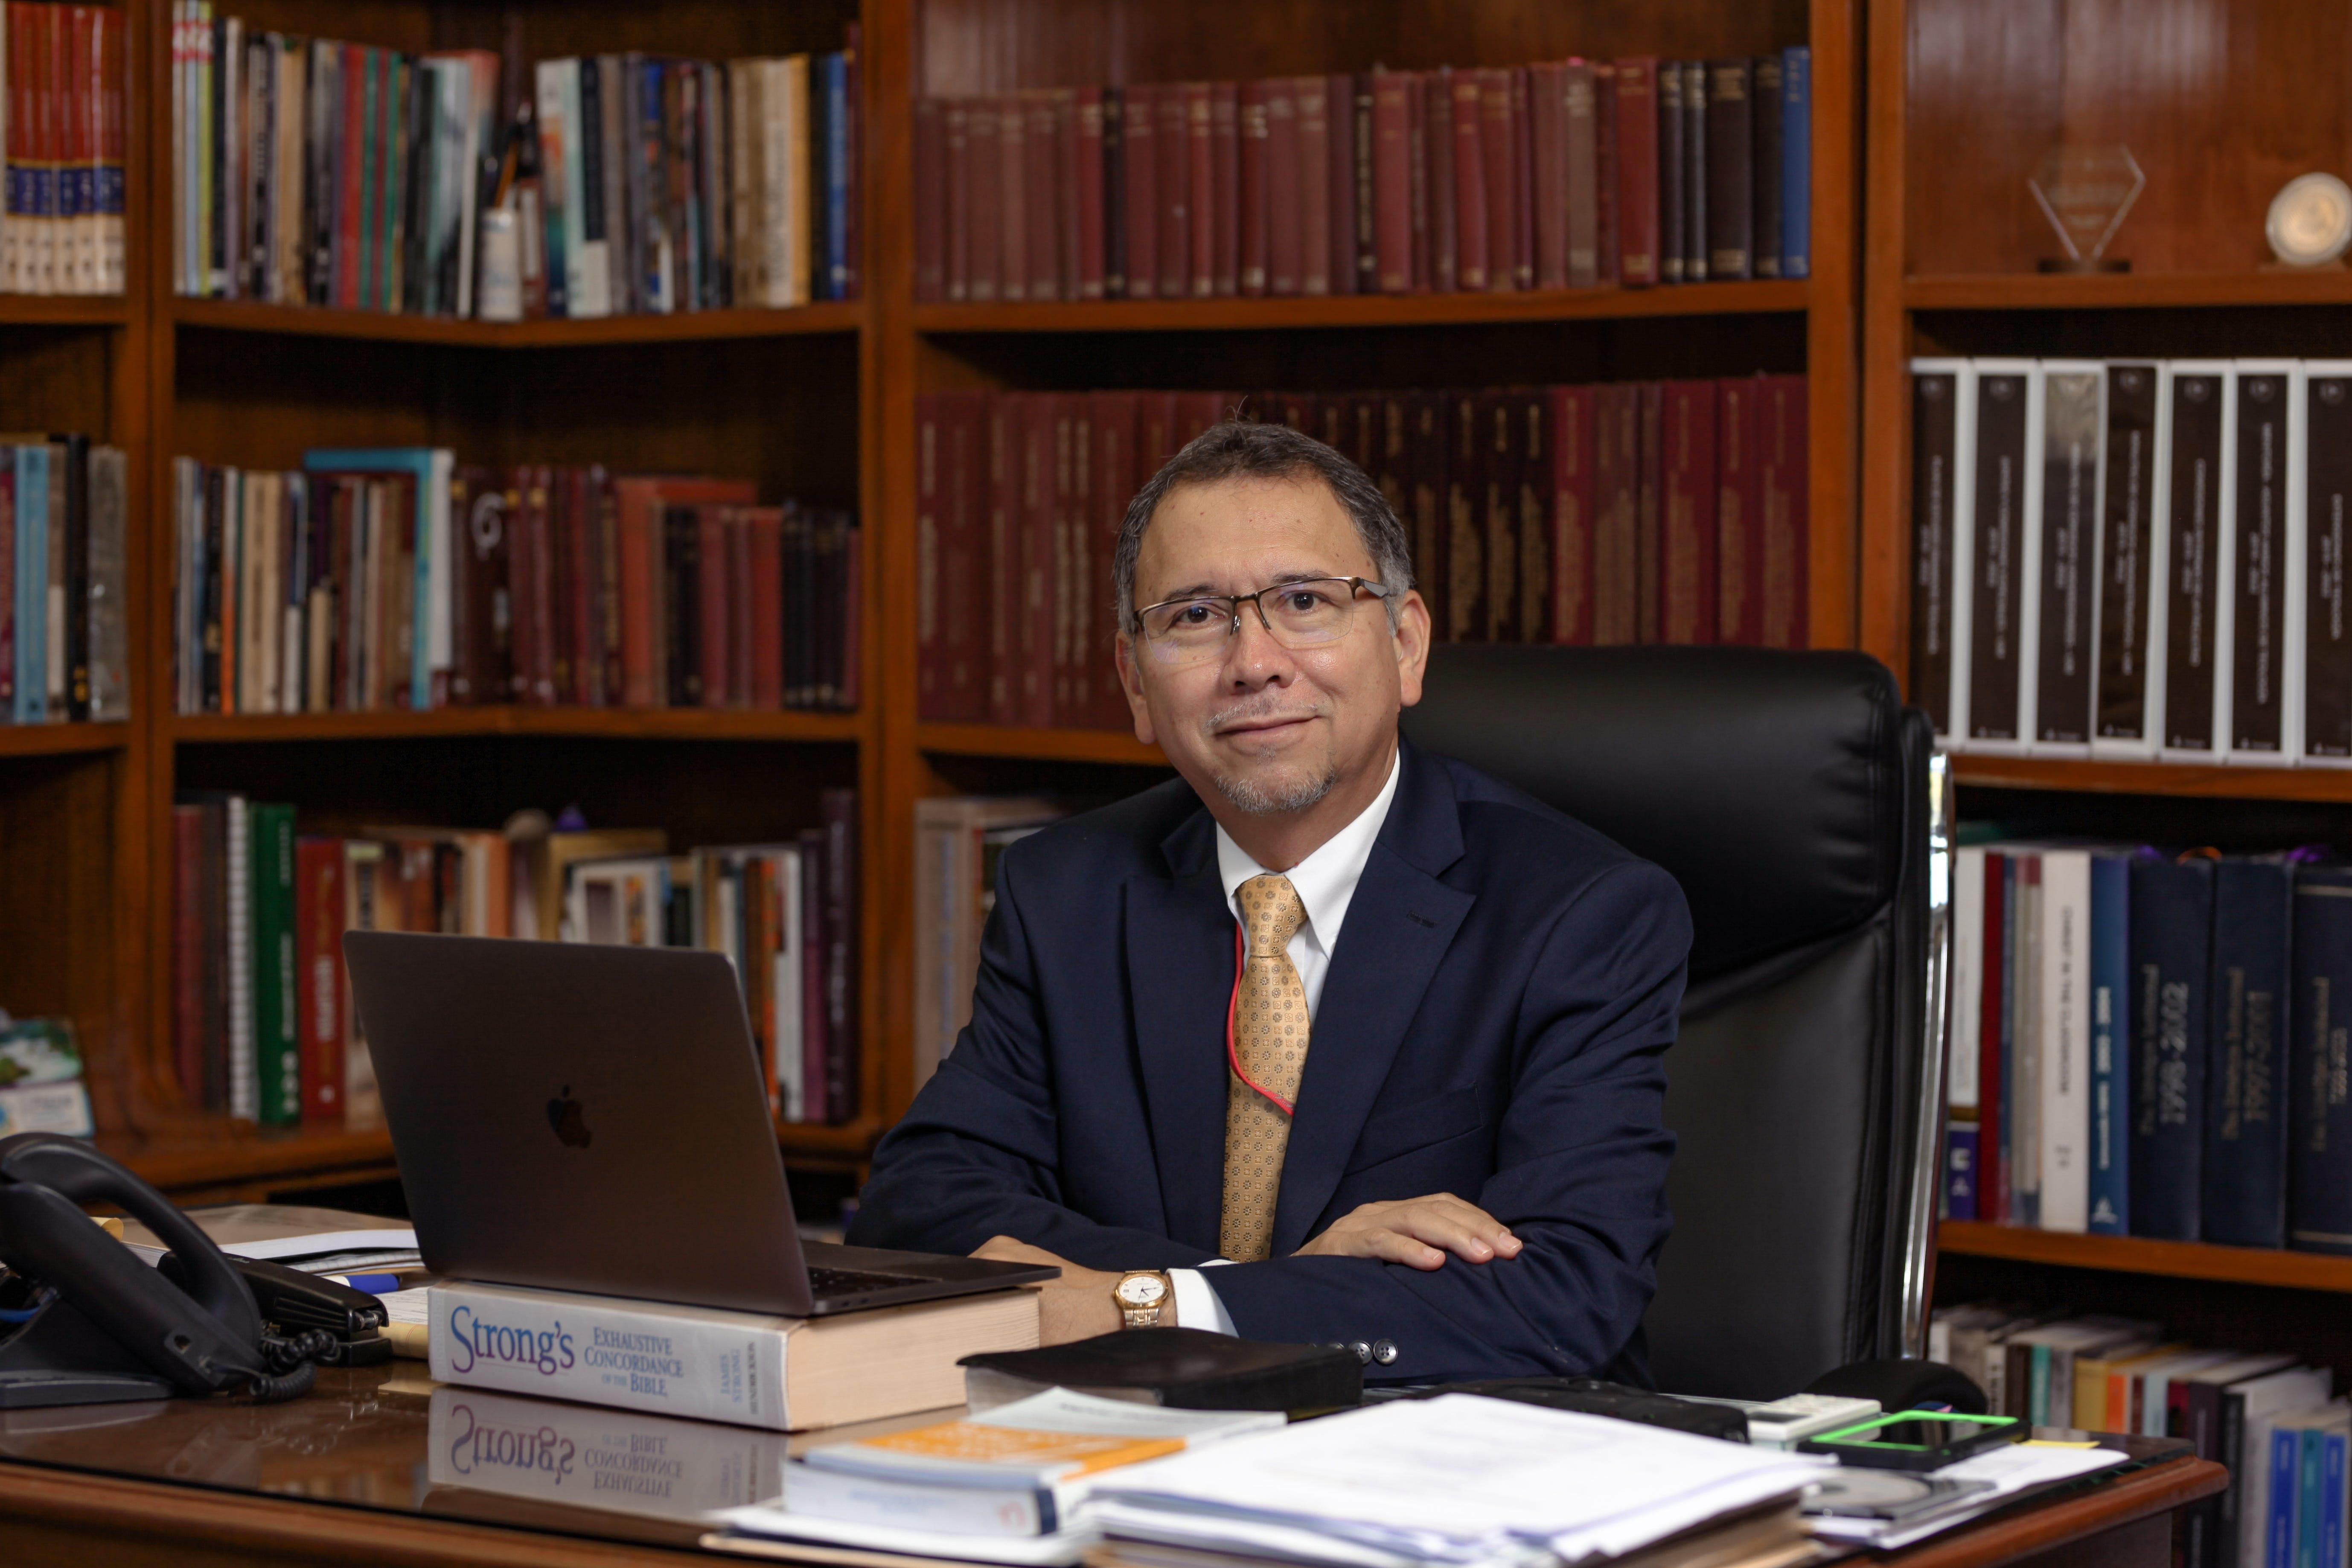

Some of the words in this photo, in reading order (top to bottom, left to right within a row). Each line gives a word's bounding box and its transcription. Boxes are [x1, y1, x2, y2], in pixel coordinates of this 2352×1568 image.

[451, 1305, 574, 1375] Strong's
[594, 1326, 672, 1356] EXHAUSTIVE
[584, 1346, 684, 1378] CONCORDANCE
[630, 1373, 667, 1396] BIBLE
